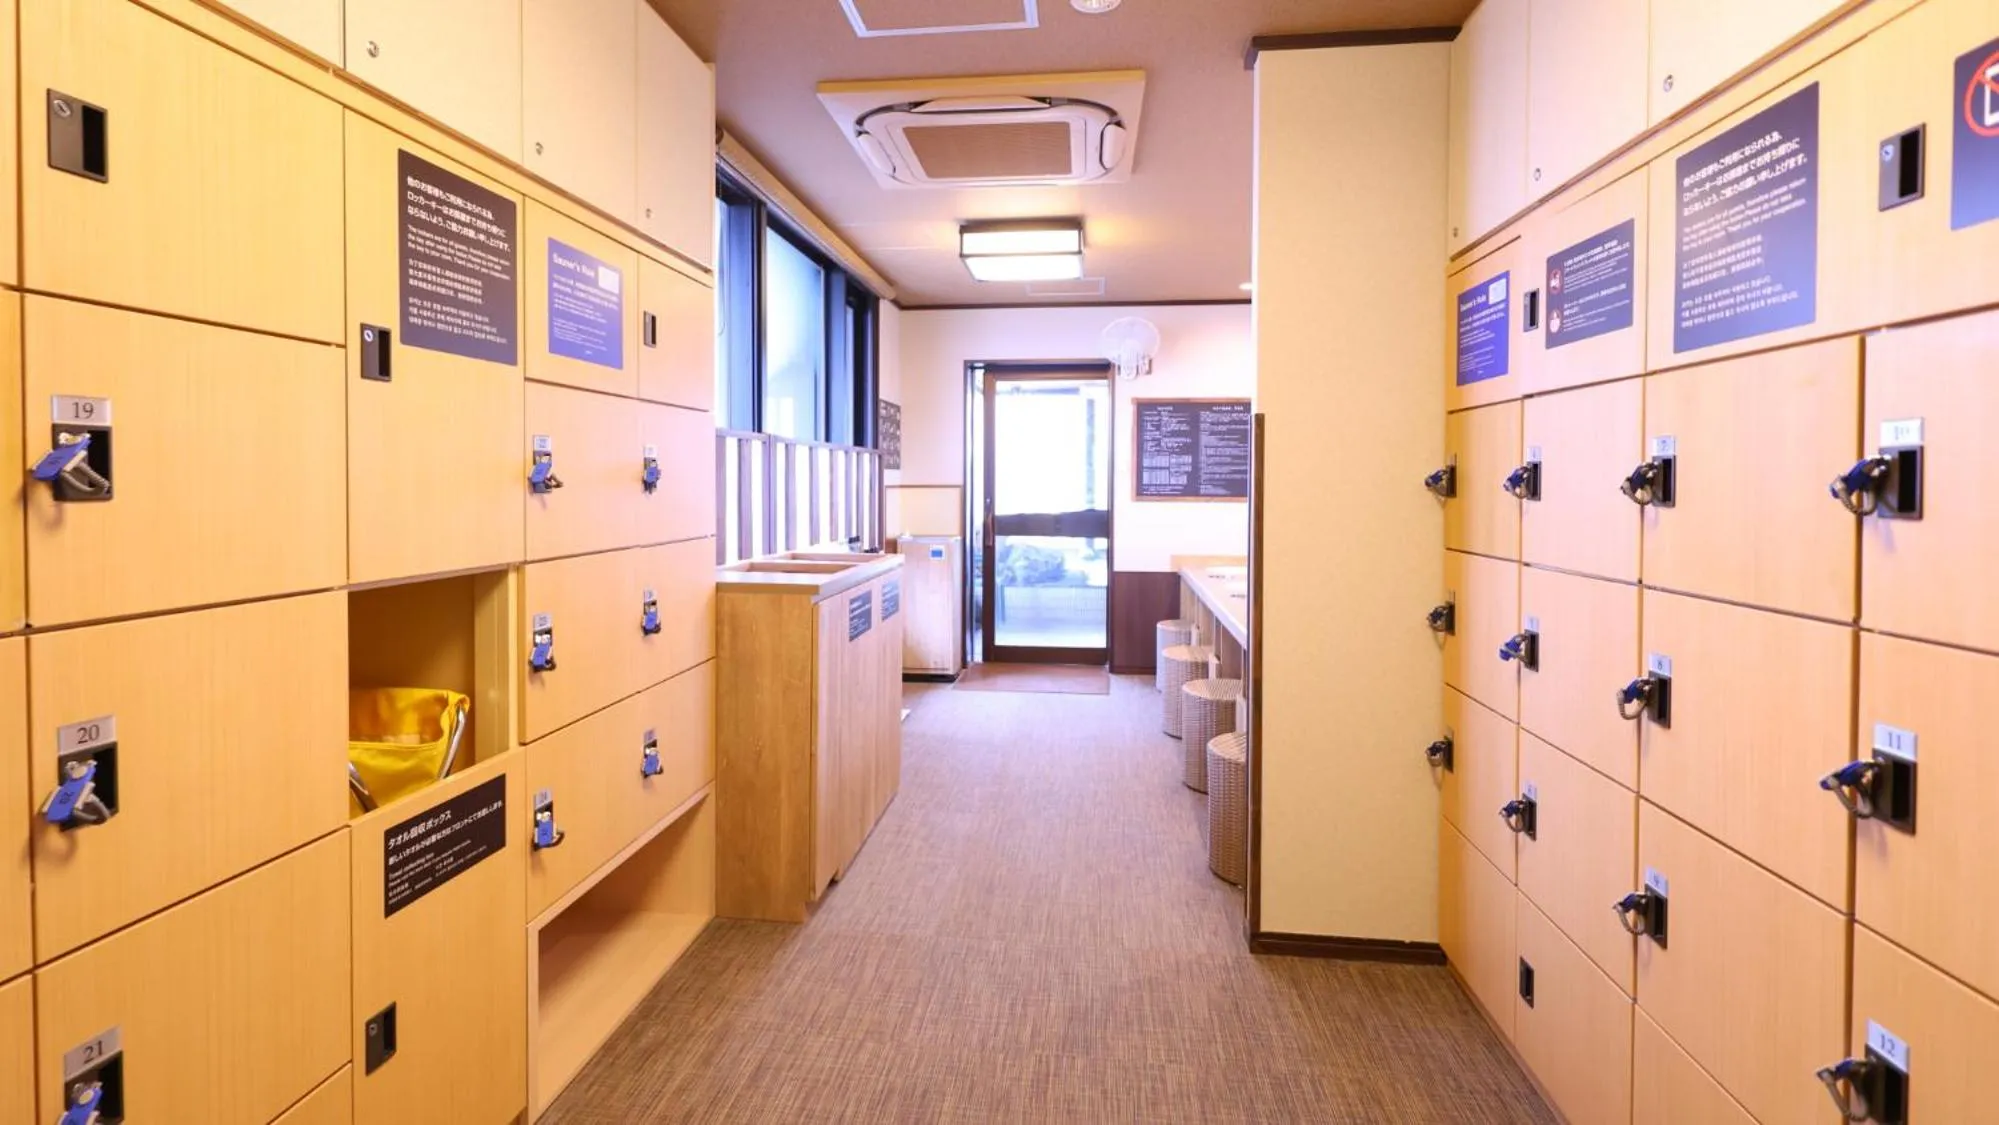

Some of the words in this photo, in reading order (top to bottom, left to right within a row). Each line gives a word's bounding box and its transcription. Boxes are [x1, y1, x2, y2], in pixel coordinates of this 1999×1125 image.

[71, 401, 95, 420] 19
[76, 724, 100, 744] 20
[1887, 732, 1903, 750] 11
[387, 809, 451, 849] タオル回収ボックス
[83, 1040, 103, 1064] 21
[1880, 1034, 1896, 1057] 12
